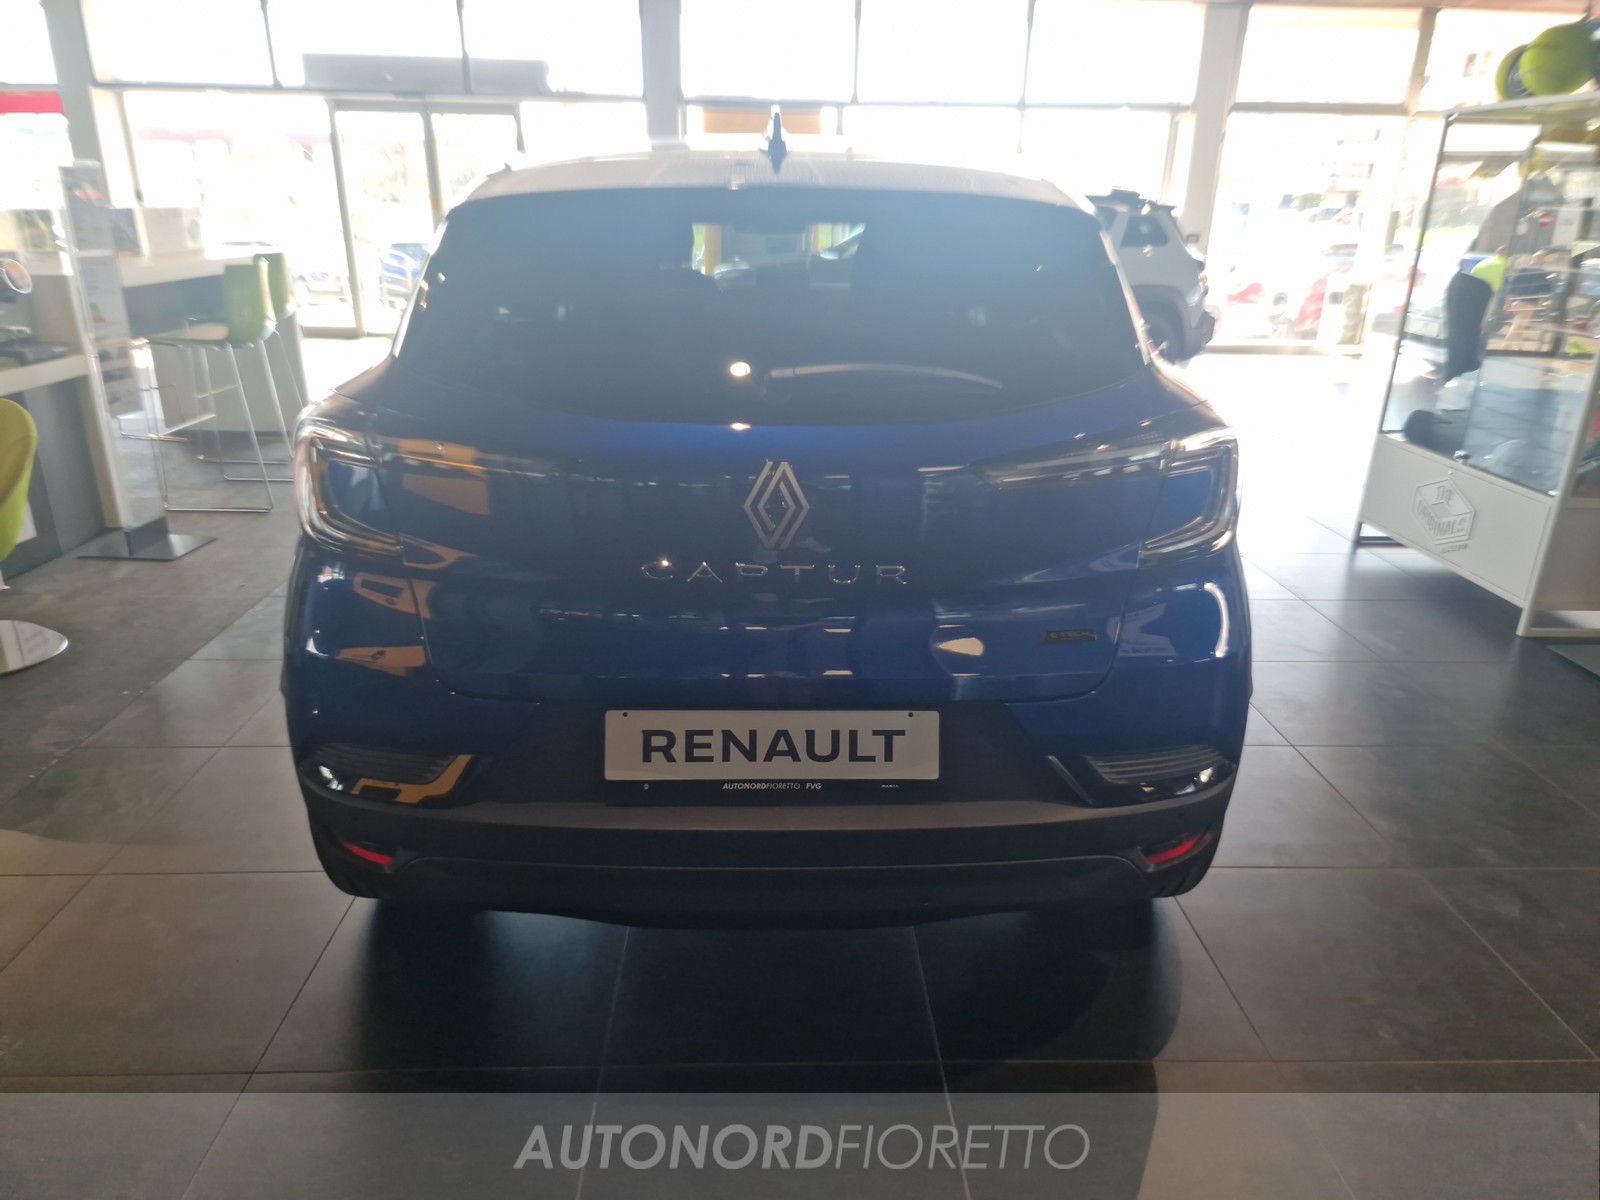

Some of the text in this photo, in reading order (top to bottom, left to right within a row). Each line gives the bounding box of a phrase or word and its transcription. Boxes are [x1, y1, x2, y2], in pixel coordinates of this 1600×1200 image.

[641, 559, 907, 585] CAPTUR
[641, 729, 906, 763] RENAULT
[722, 782, 822, 790] AUTONORDFIORETTO FVG
